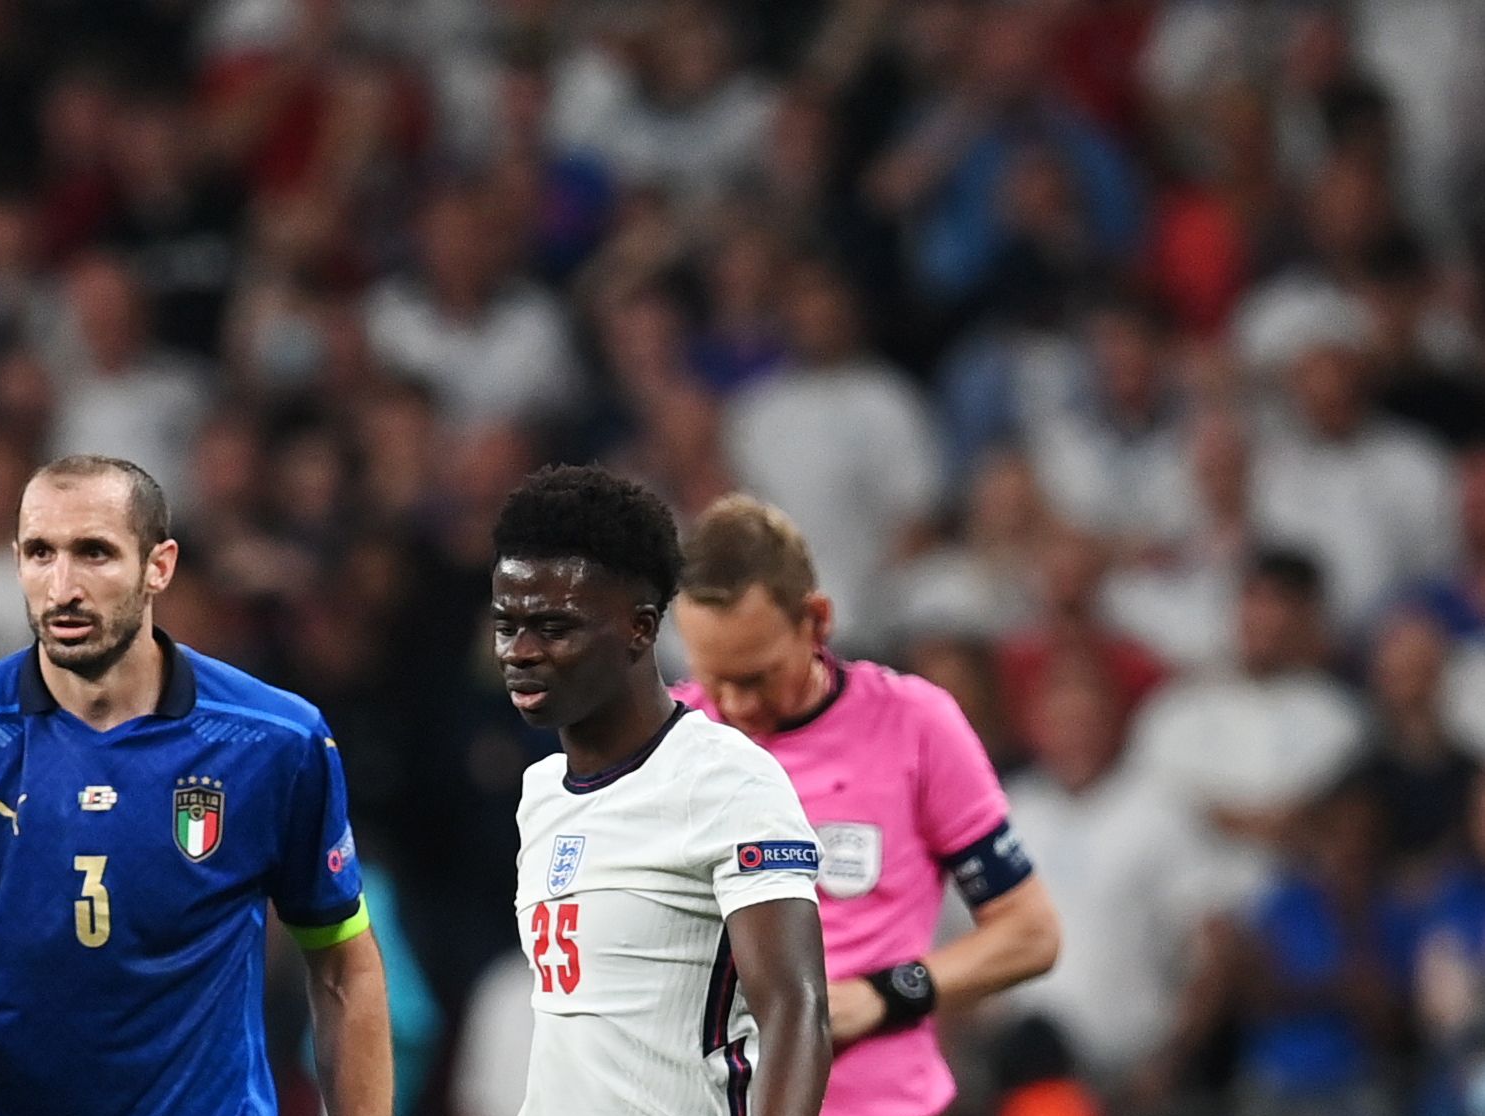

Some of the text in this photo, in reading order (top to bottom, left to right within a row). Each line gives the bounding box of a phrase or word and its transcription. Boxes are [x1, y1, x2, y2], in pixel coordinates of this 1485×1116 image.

[177, 793, 219, 806] ITALIA
[764, 848, 816, 862] RESPECT
[74, 855, 111, 948] 3
[531, 902, 581, 994] 25
